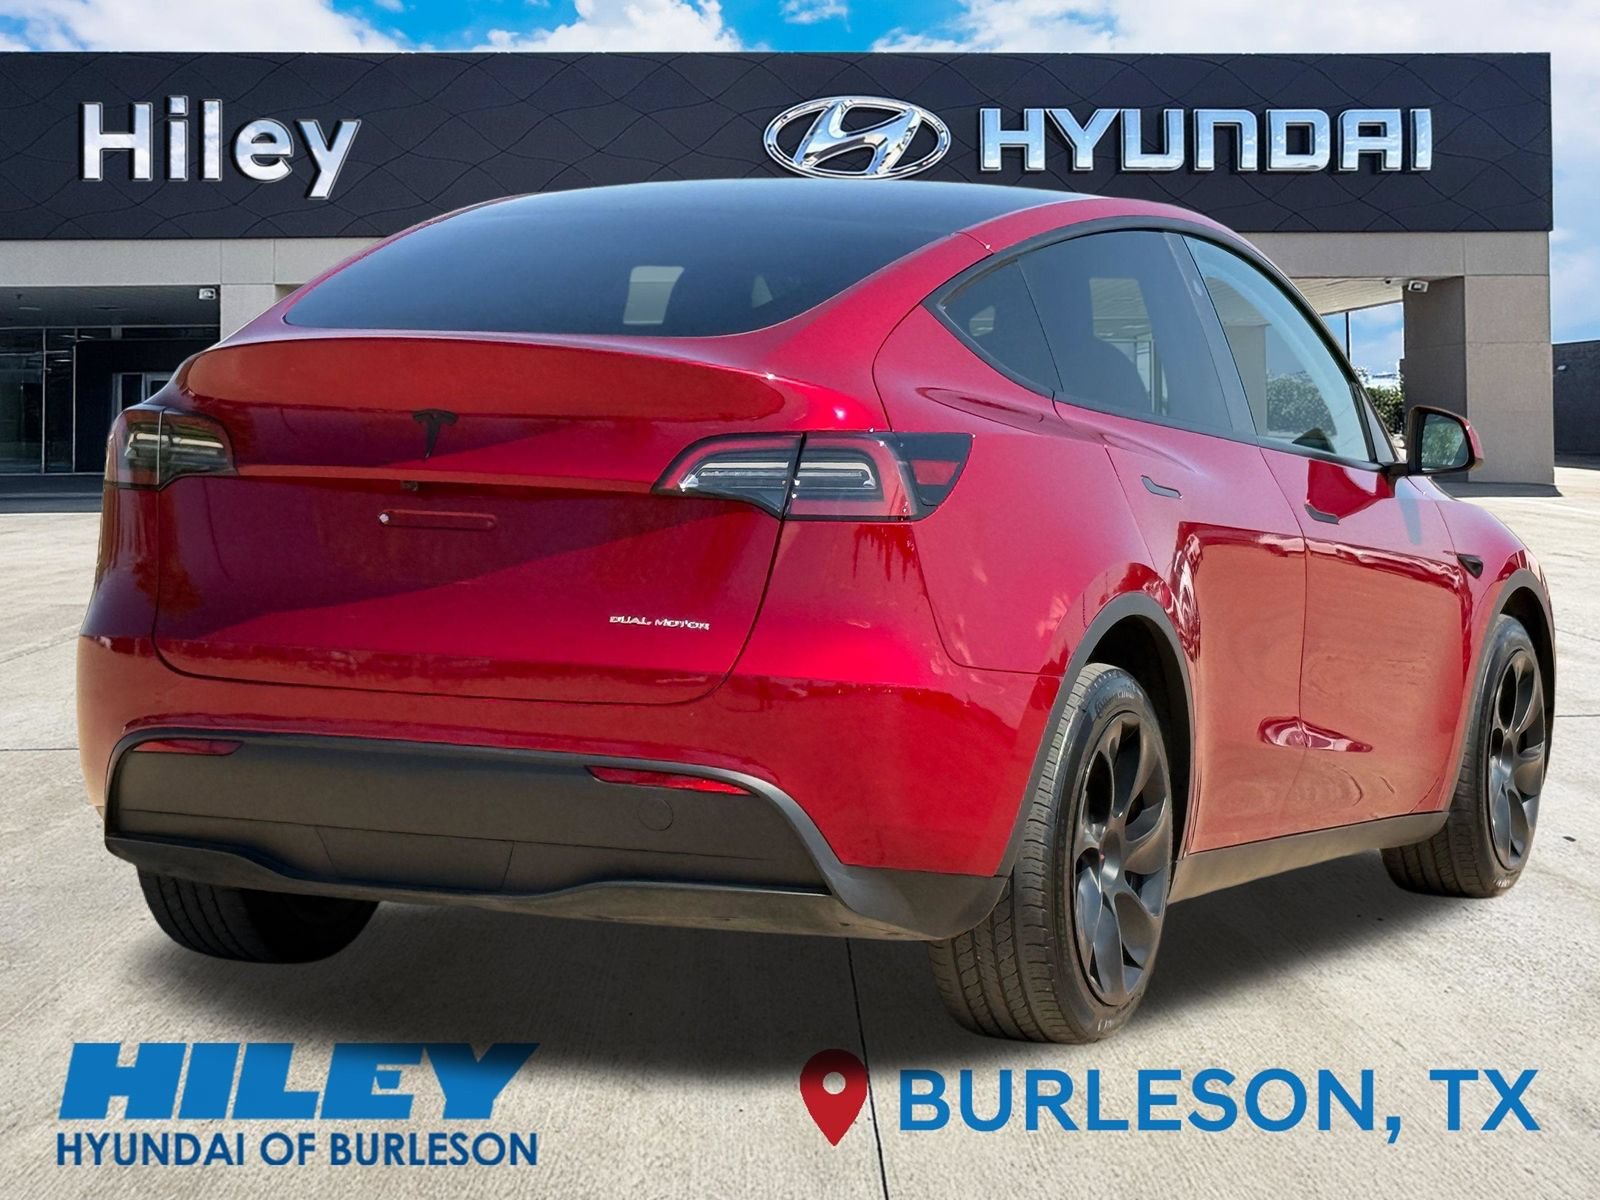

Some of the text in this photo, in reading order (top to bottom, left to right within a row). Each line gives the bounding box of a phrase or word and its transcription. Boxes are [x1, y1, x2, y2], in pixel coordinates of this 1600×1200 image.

[80, 96, 362, 200] Hiley
[980, 107, 1434, 173] HYUNDAI
[609, 615, 710, 631] DUAL MOTOR
